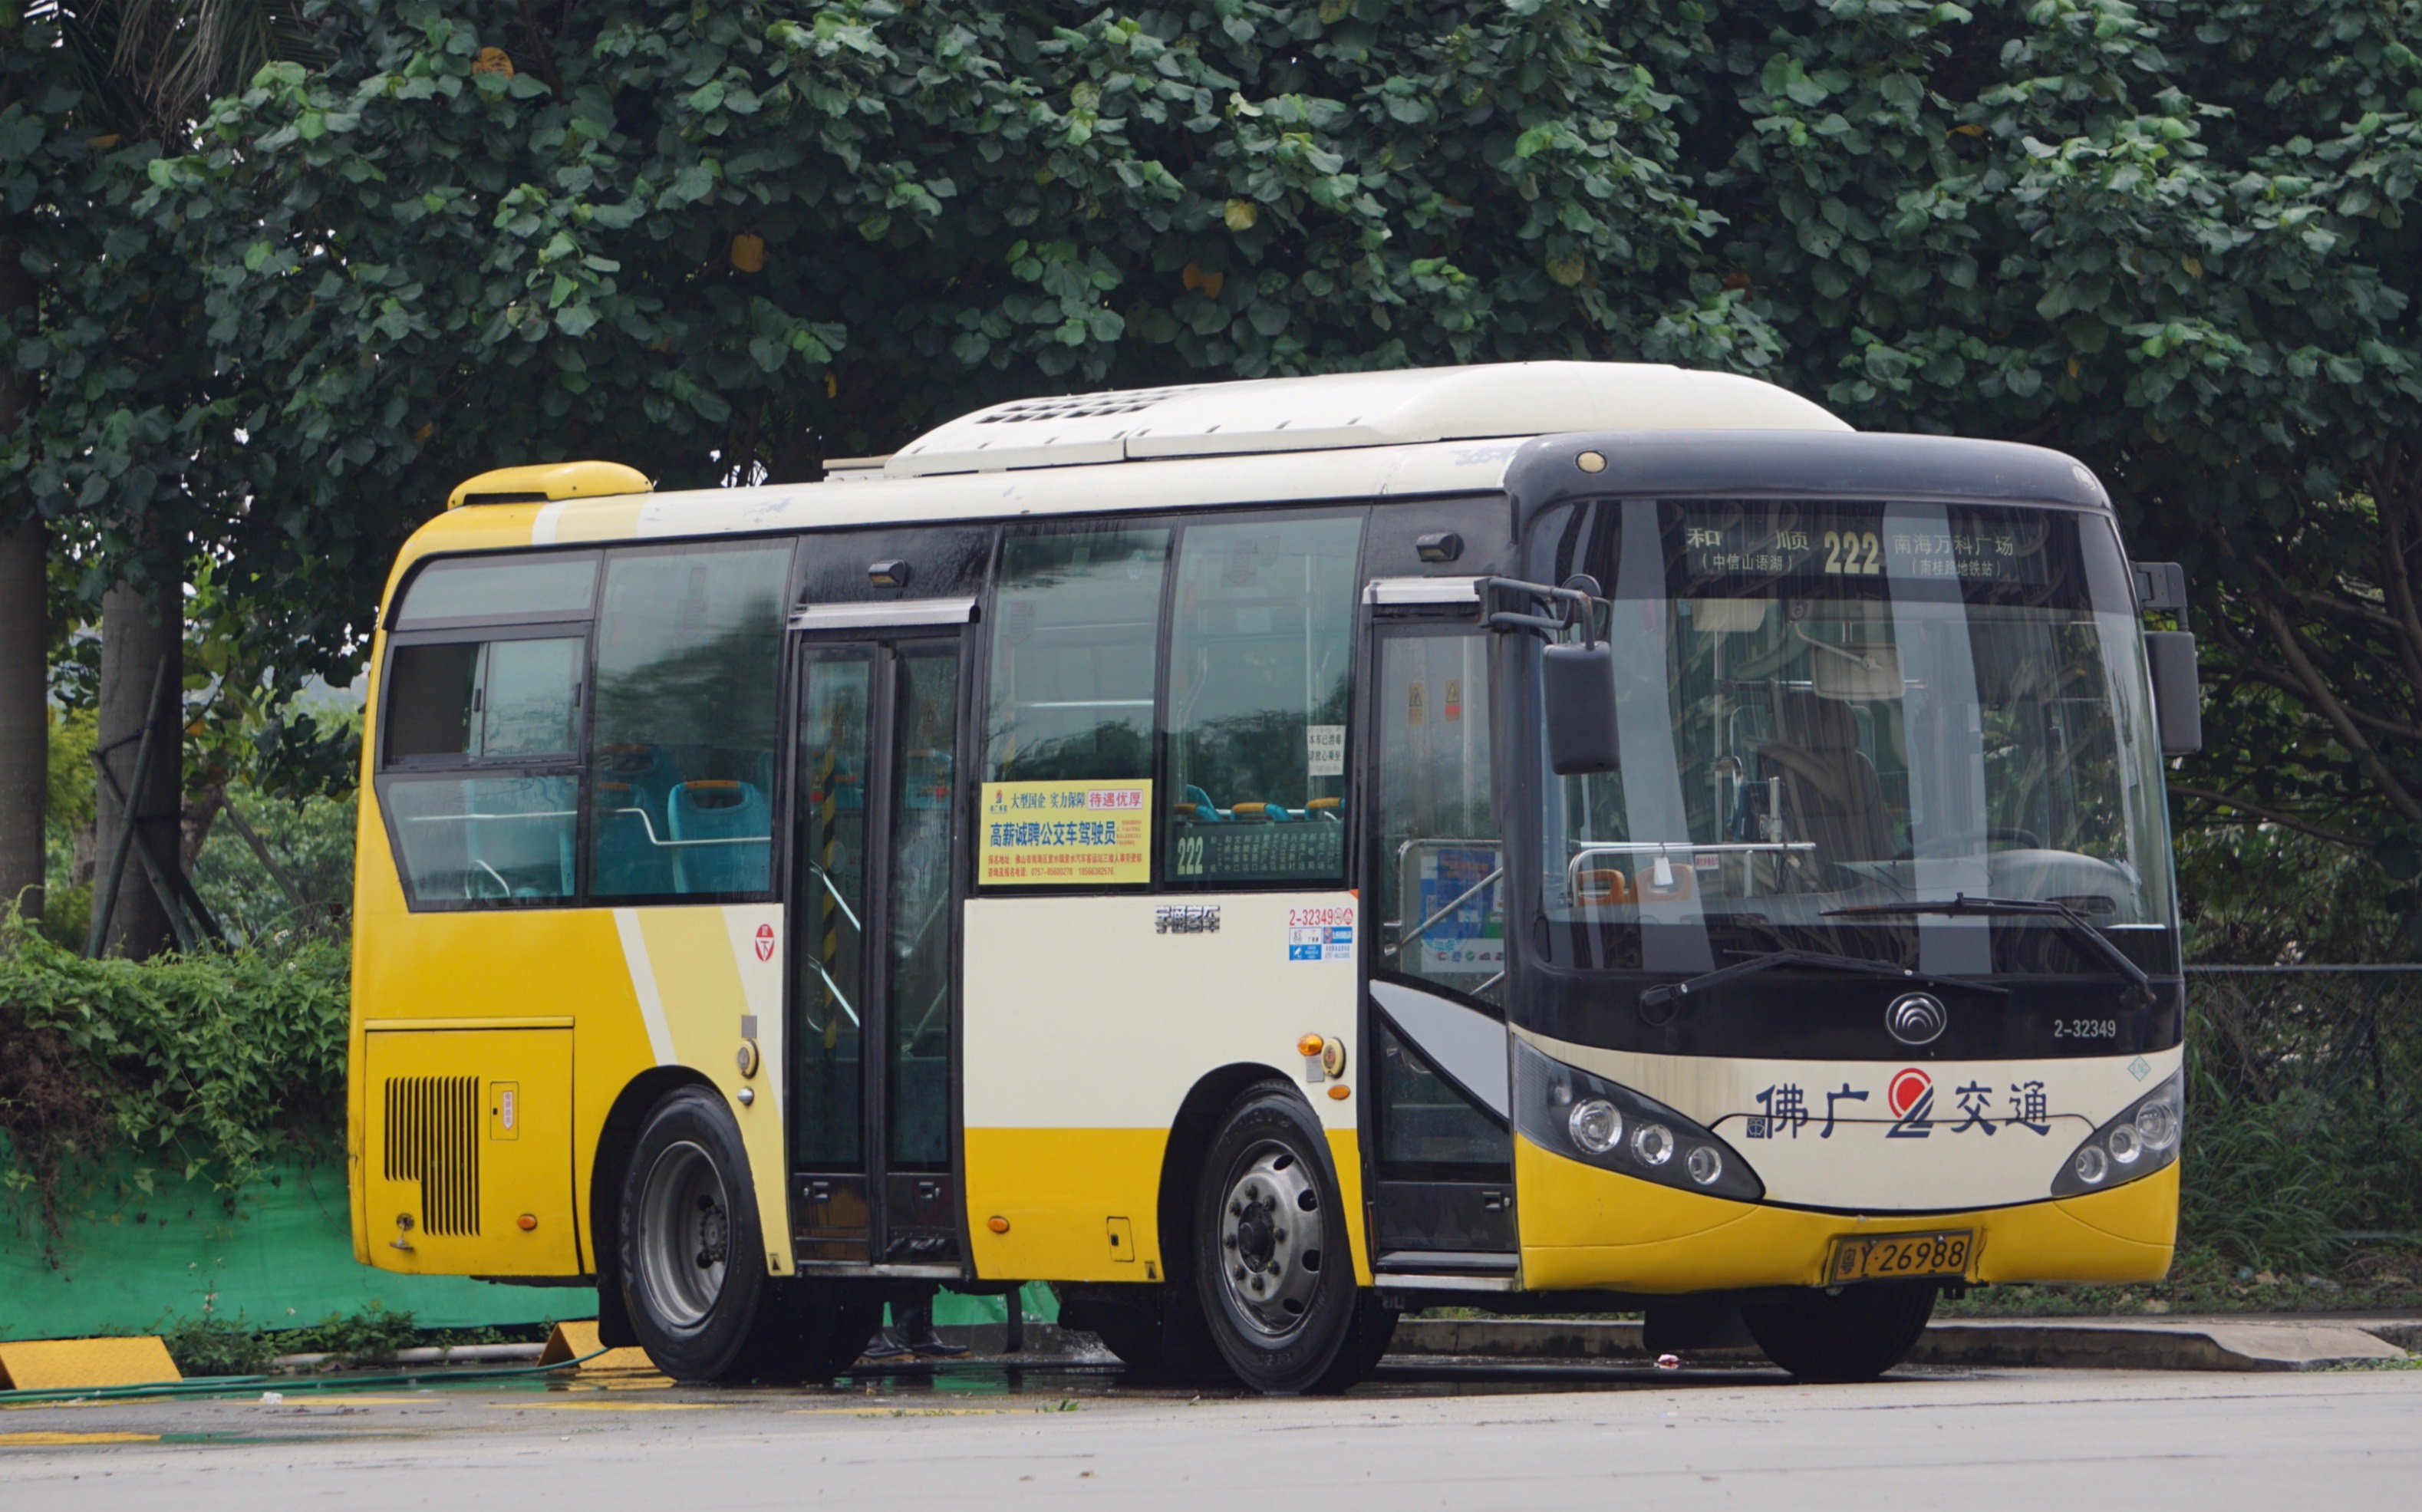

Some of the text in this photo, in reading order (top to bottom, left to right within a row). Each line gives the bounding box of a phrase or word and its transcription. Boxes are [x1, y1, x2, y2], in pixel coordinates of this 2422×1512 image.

[1824, 529, 1880, 575] 222
[1892, 532, 2014, 556] 南海万科广场
[1309, 734, 1341, 746] 本车已消毒
[1309, 749, 1341, 762] 请放心乘坐
[1011, 792, 1046, 809] 大型国企
[1050, 791, 1086, 809] 实力保障
[1089, 792, 1142, 807] 待遇优厚
[990, 820, 1116, 848] 高薪诚聘公交车驾驶员
[1177, 835, 1203, 875] 222
[1290, 908, 1333, 925] 2-32349
[2054, 1019, 2117, 1039] 2-32349
